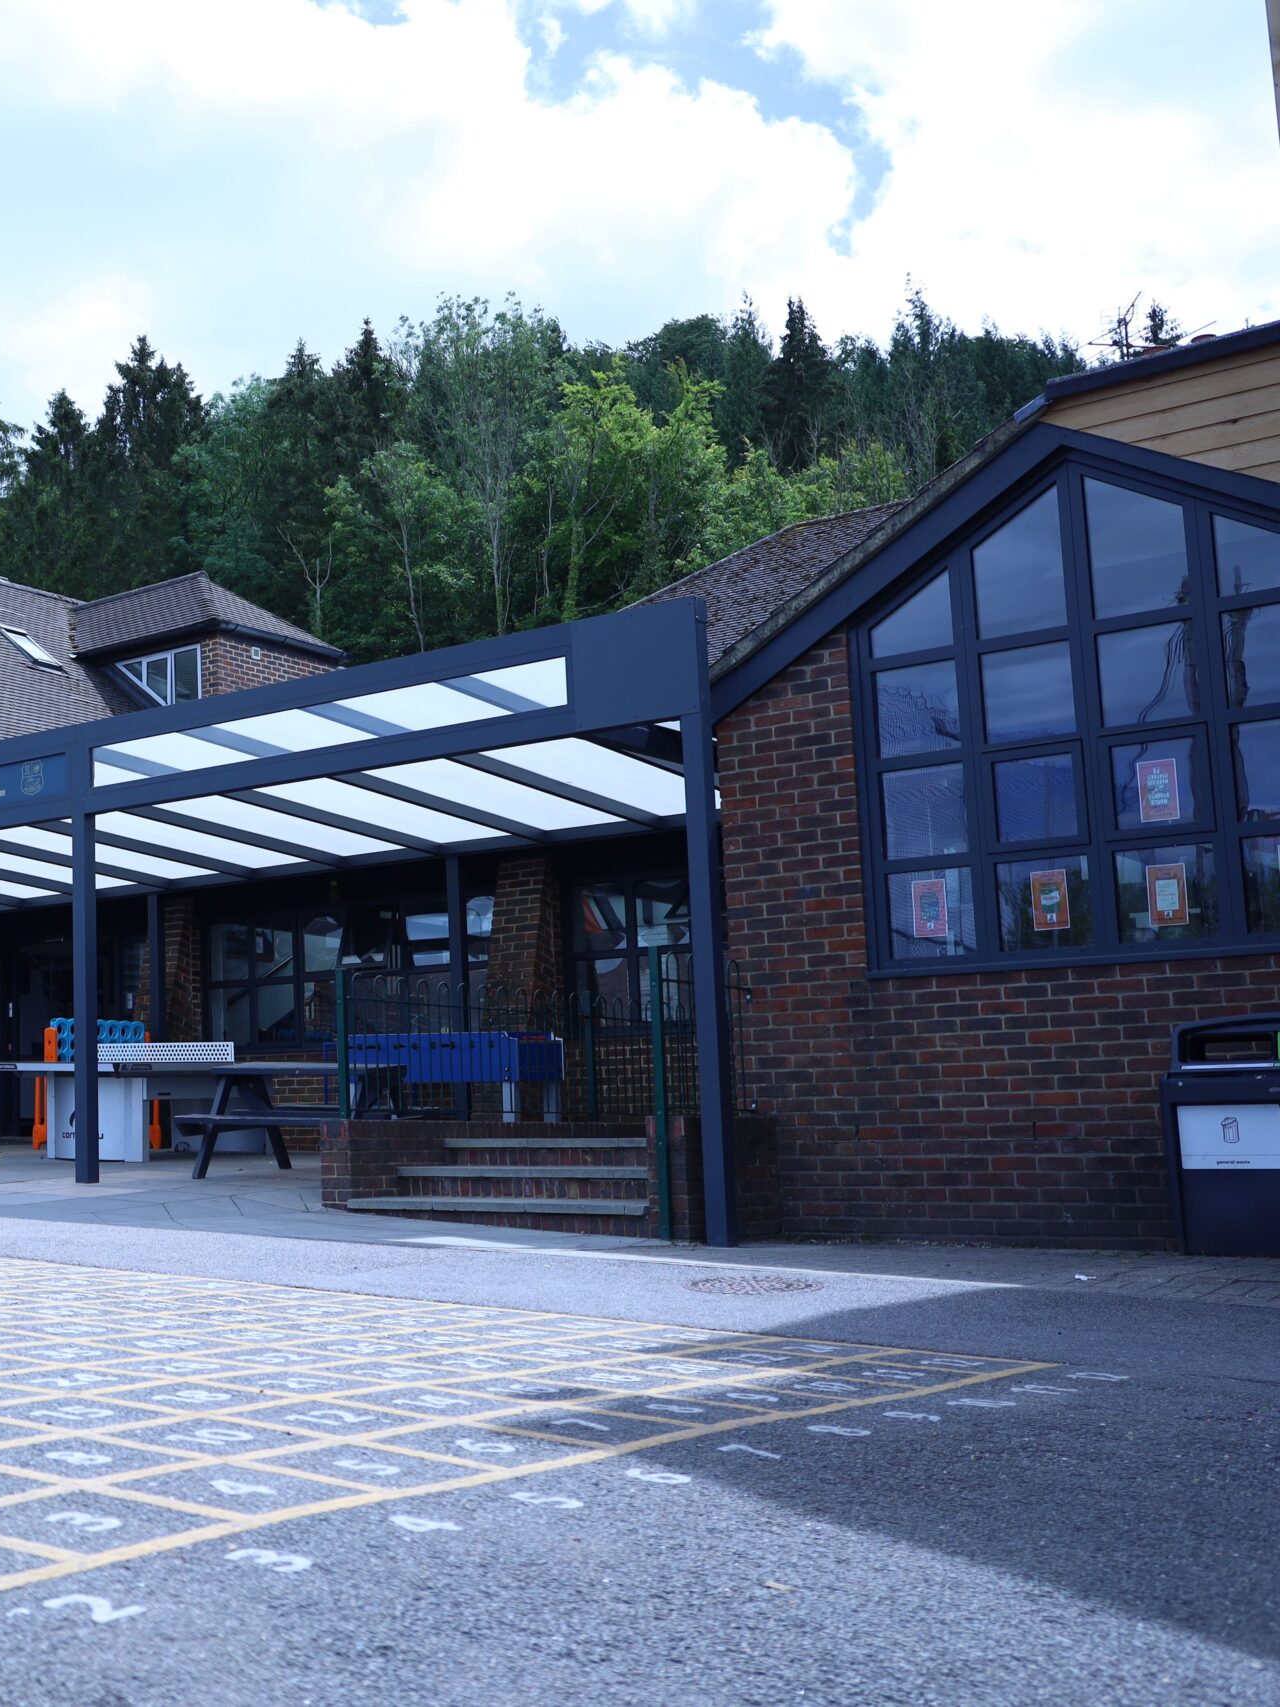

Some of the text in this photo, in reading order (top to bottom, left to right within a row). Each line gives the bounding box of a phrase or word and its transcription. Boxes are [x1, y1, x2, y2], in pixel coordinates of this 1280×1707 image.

[441, 1356, 511, 1369] 27
[647, 1363, 718, 1375] 20
[28, 1372, 119, 1387] 24
[860, 1368, 926, 1380] 11
[255, 1377, 340, 1389] 21
[794, 1381, 860, 1393] 10
[151, 1390, 231, 1404] 18
[392, 1395, 471, 1408] 14
[29, 1405, 116, 1420] 15
[282, 1409, 374, 1426] 12
[882, 1410, 942, 1422] 9
[555, 1418, 610, 1430] 7
[806, 1424, 871, 1437] 8
[164, 1428, 256, 1446] 10
[454, 1438, 518, 1456] 6
[716, 1443, 781, 1459] 7
[45, 1451, 112, 1465] 8
[333, 1458, 402, 1476] 5
[624, 1468, 692, 1485] 6
[210, 1478, 277, 1495] 4
[510, 1491, 584, 1509] 5
[44, 1511, 123, 1532] 3
[387, 1514, 463, 1533] 4
[223, 1548, 313, 1573] 3
[41, 1593, 147, 1624] 2
